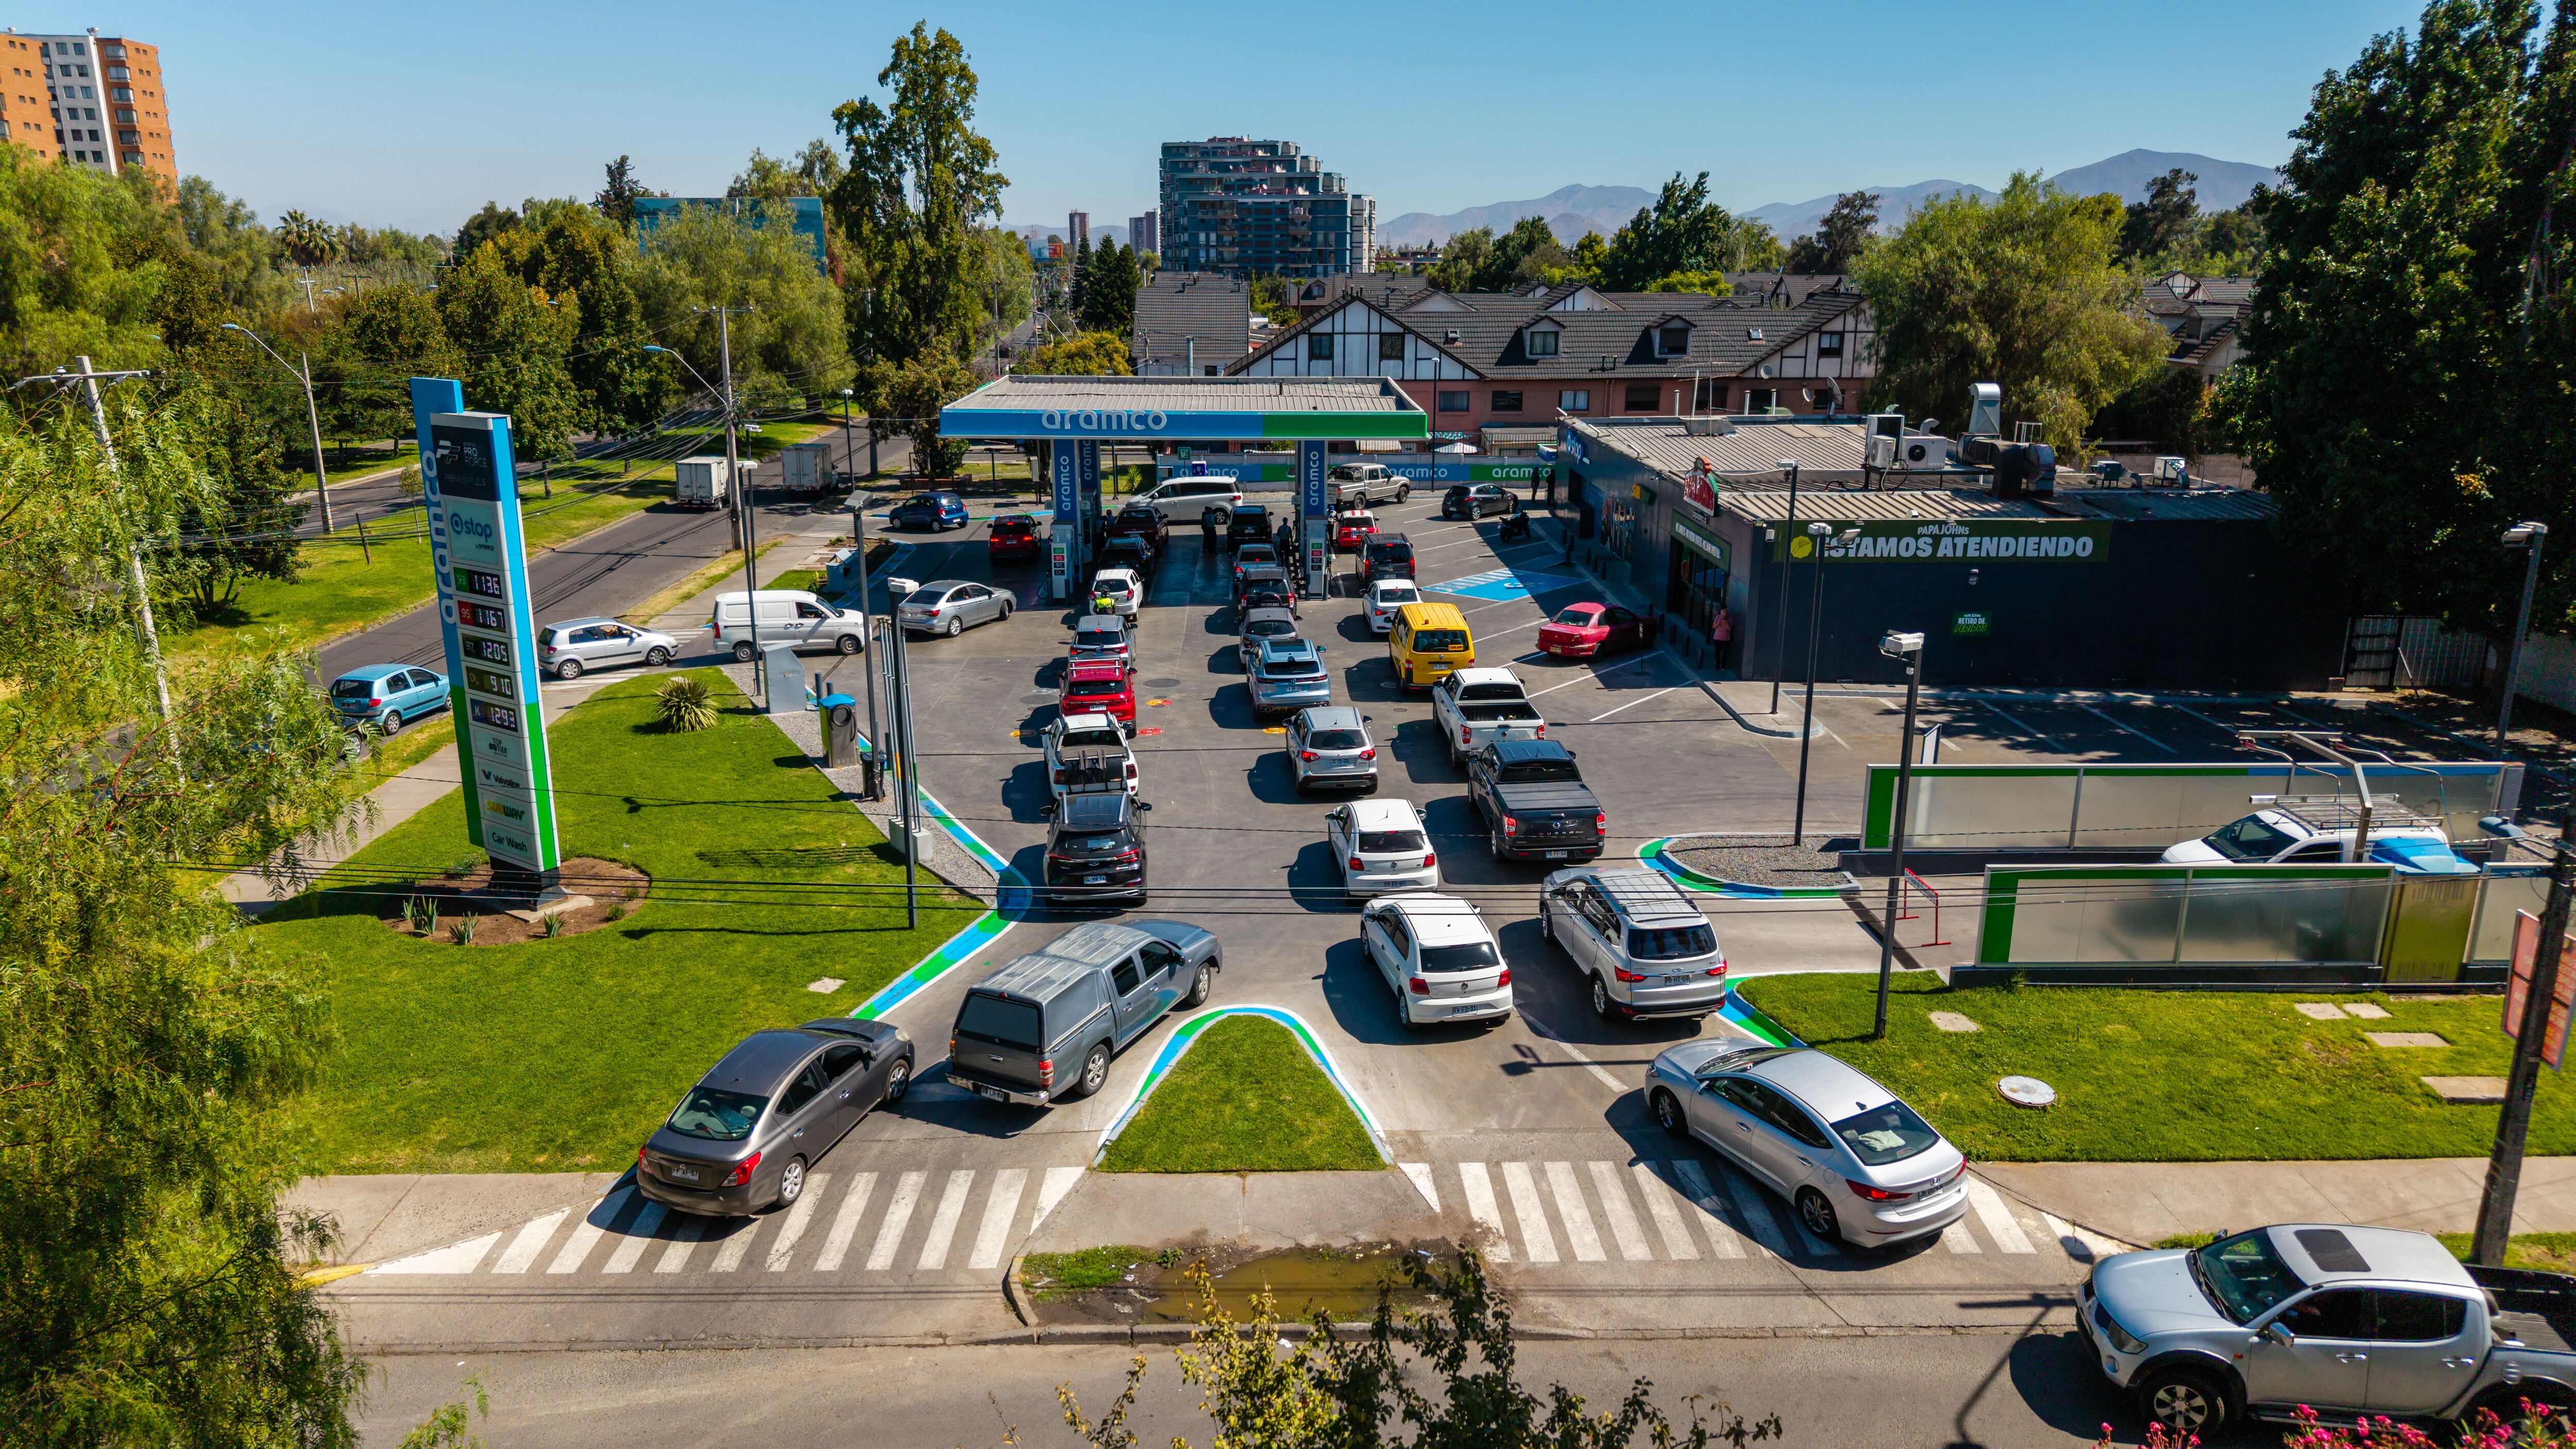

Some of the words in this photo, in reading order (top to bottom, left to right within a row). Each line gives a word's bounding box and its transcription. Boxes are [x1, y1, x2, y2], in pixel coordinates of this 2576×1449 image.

[1042, 410, 1167, 430] aramco
[464, 447, 478, 456] PRO
[465, 456, 487, 468] FORCE
[1083, 439, 1092, 480] aramc
[1310, 451, 1319, 506] aramco
[1493, 468, 1551, 478] aramo
[1060, 456, 1071, 511] aramco
[1918, 525, 1939, 535] PAPA
[422, 450, 456, 624] aramco
[1937, 537, 2093, 557] ATENDIENDO
[457, 574, 466, 585] 93
[461, 608, 471, 618] 95
[1954, 623, 1988, 633] PEDIDOS
[466, 641, 474, 651] 97
[474, 705, 481, 717] K
[498, 745, 507, 755] TIER
[493, 774, 520, 788] Valvoline
[486, 800, 525, 821] SUBWAY
[492, 832, 504, 845] Car
[506, 836, 528, 853] Wash
